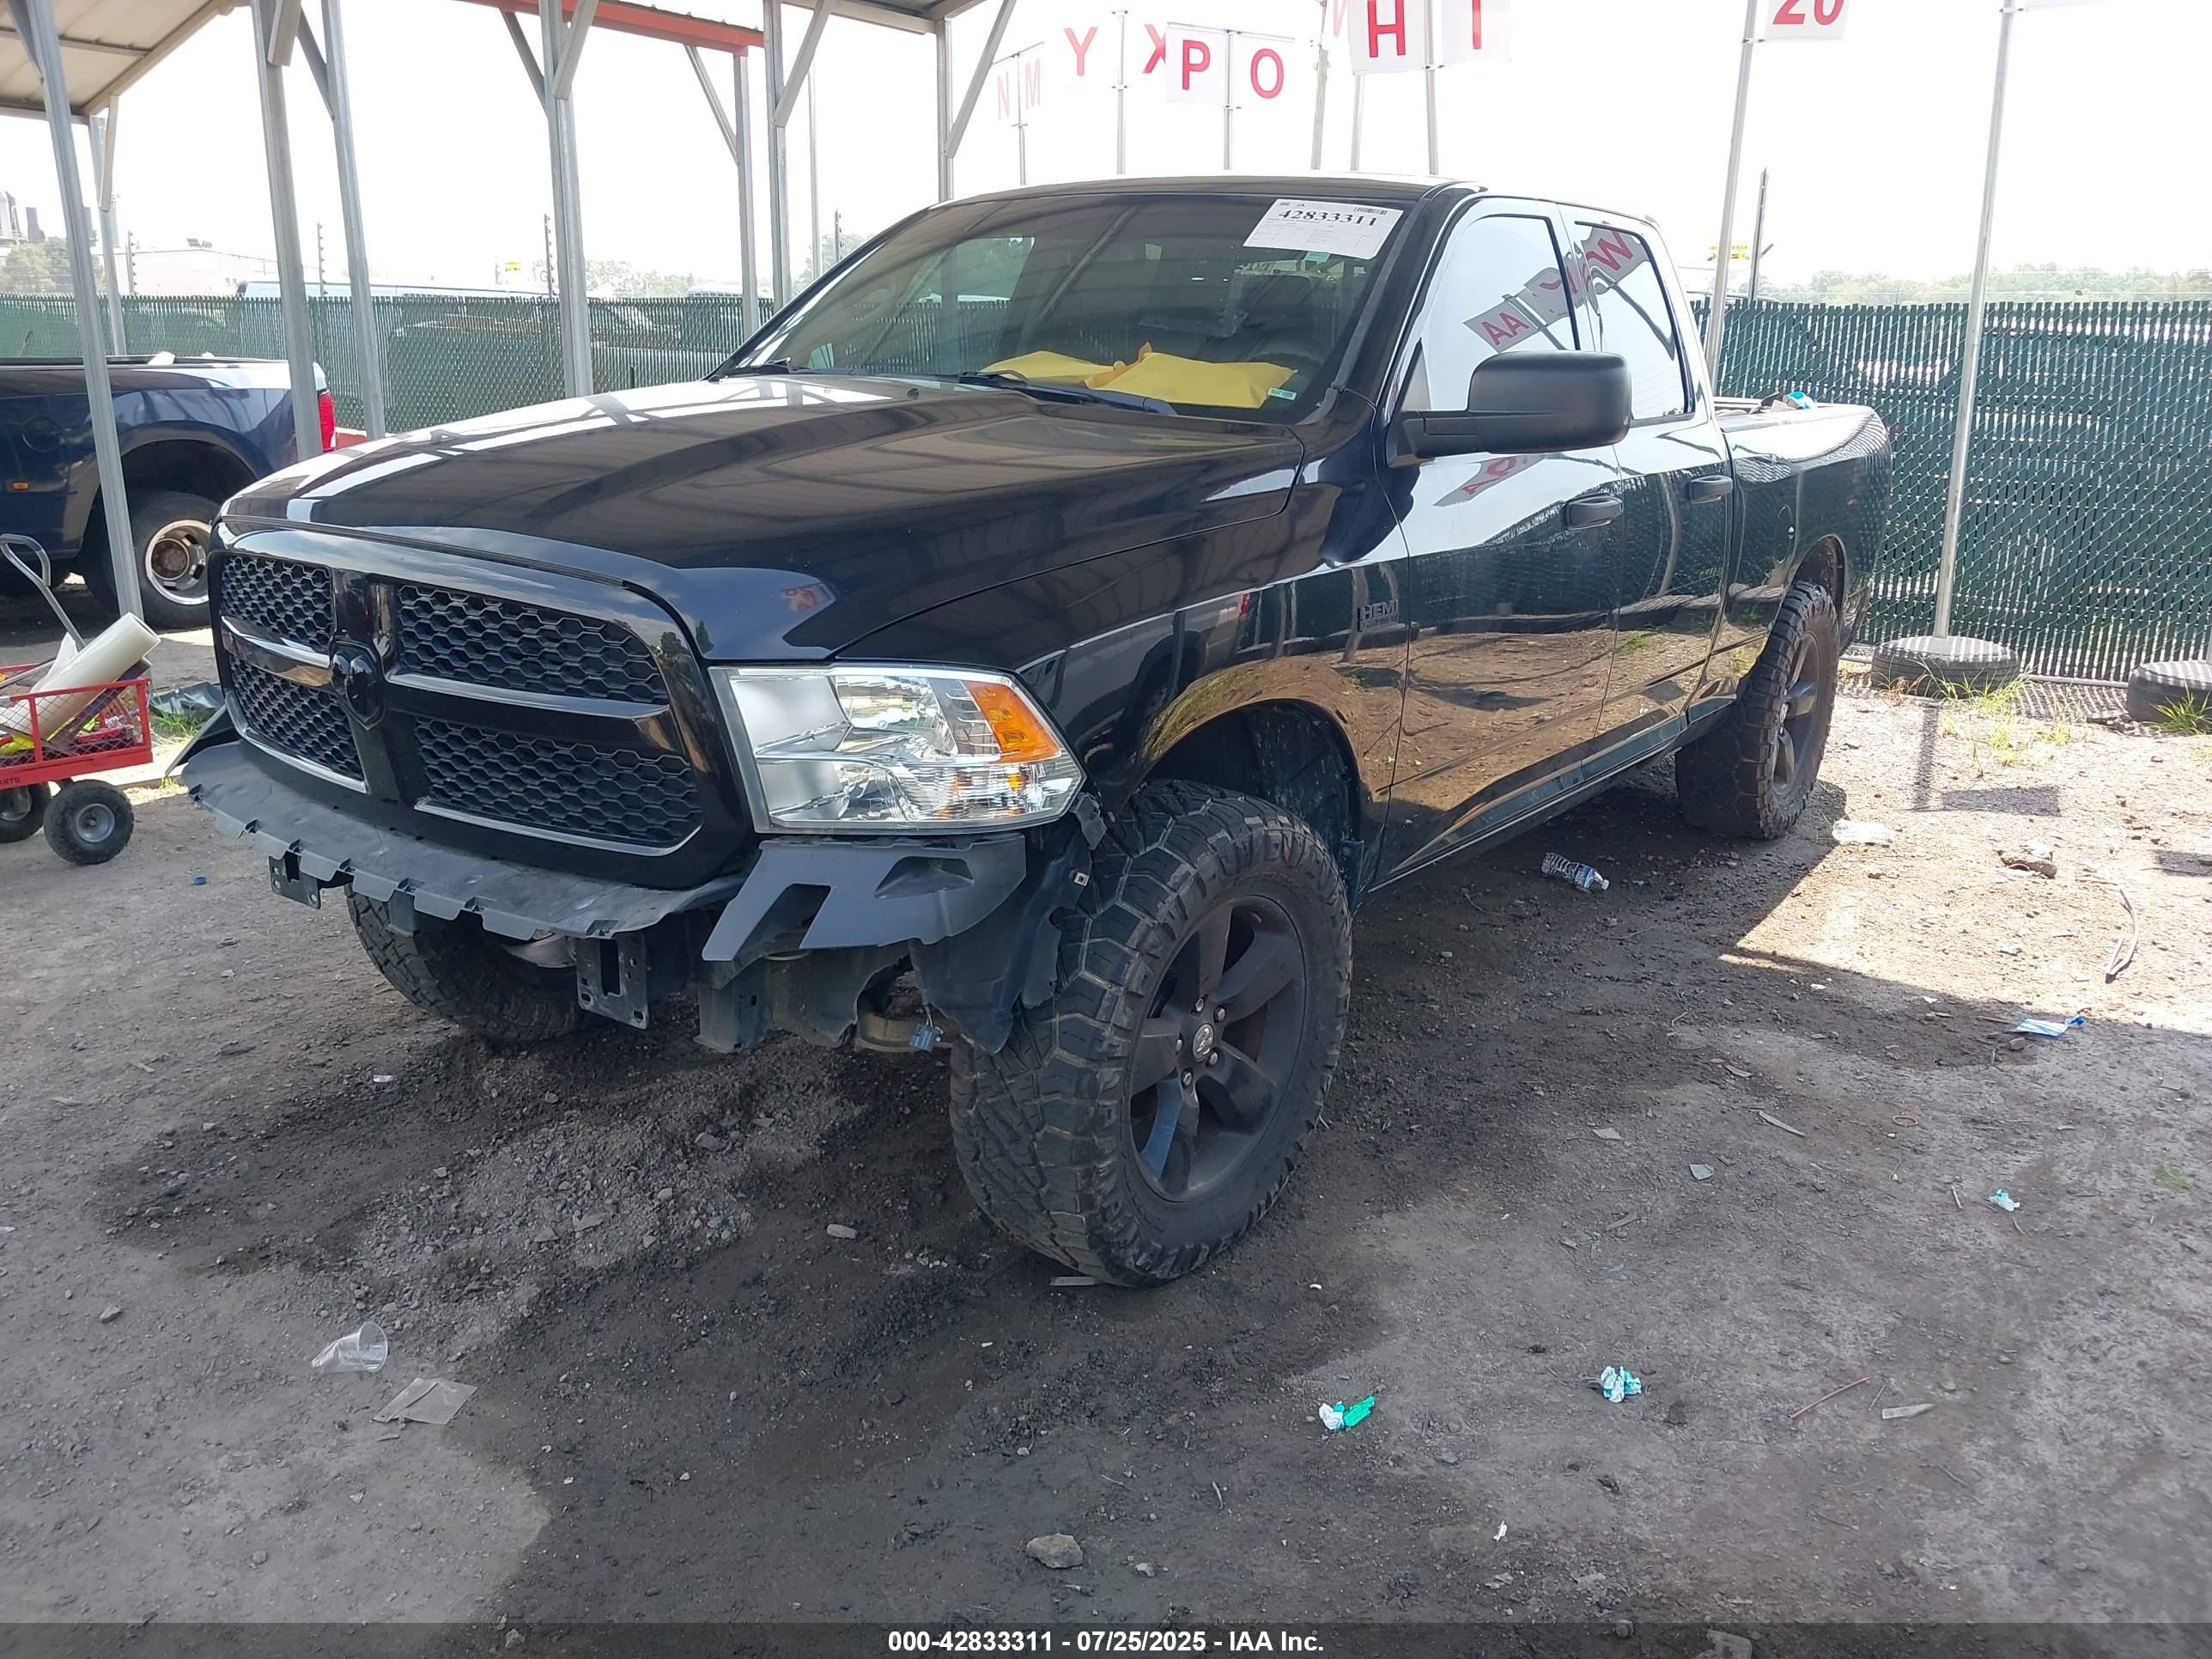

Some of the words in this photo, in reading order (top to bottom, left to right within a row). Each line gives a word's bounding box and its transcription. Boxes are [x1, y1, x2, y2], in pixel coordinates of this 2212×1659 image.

[1064, 27, 1098, 76] Y
[1367, 0, 1406, 58] H
[1025, 58, 1041, 110] M
[1182, 40, 1211, 90] P
[1250, 48, 1285, 99] O
[1278, 210, 1377, 226] 42833311
[1360, 599, 1399, 618] HEMI
